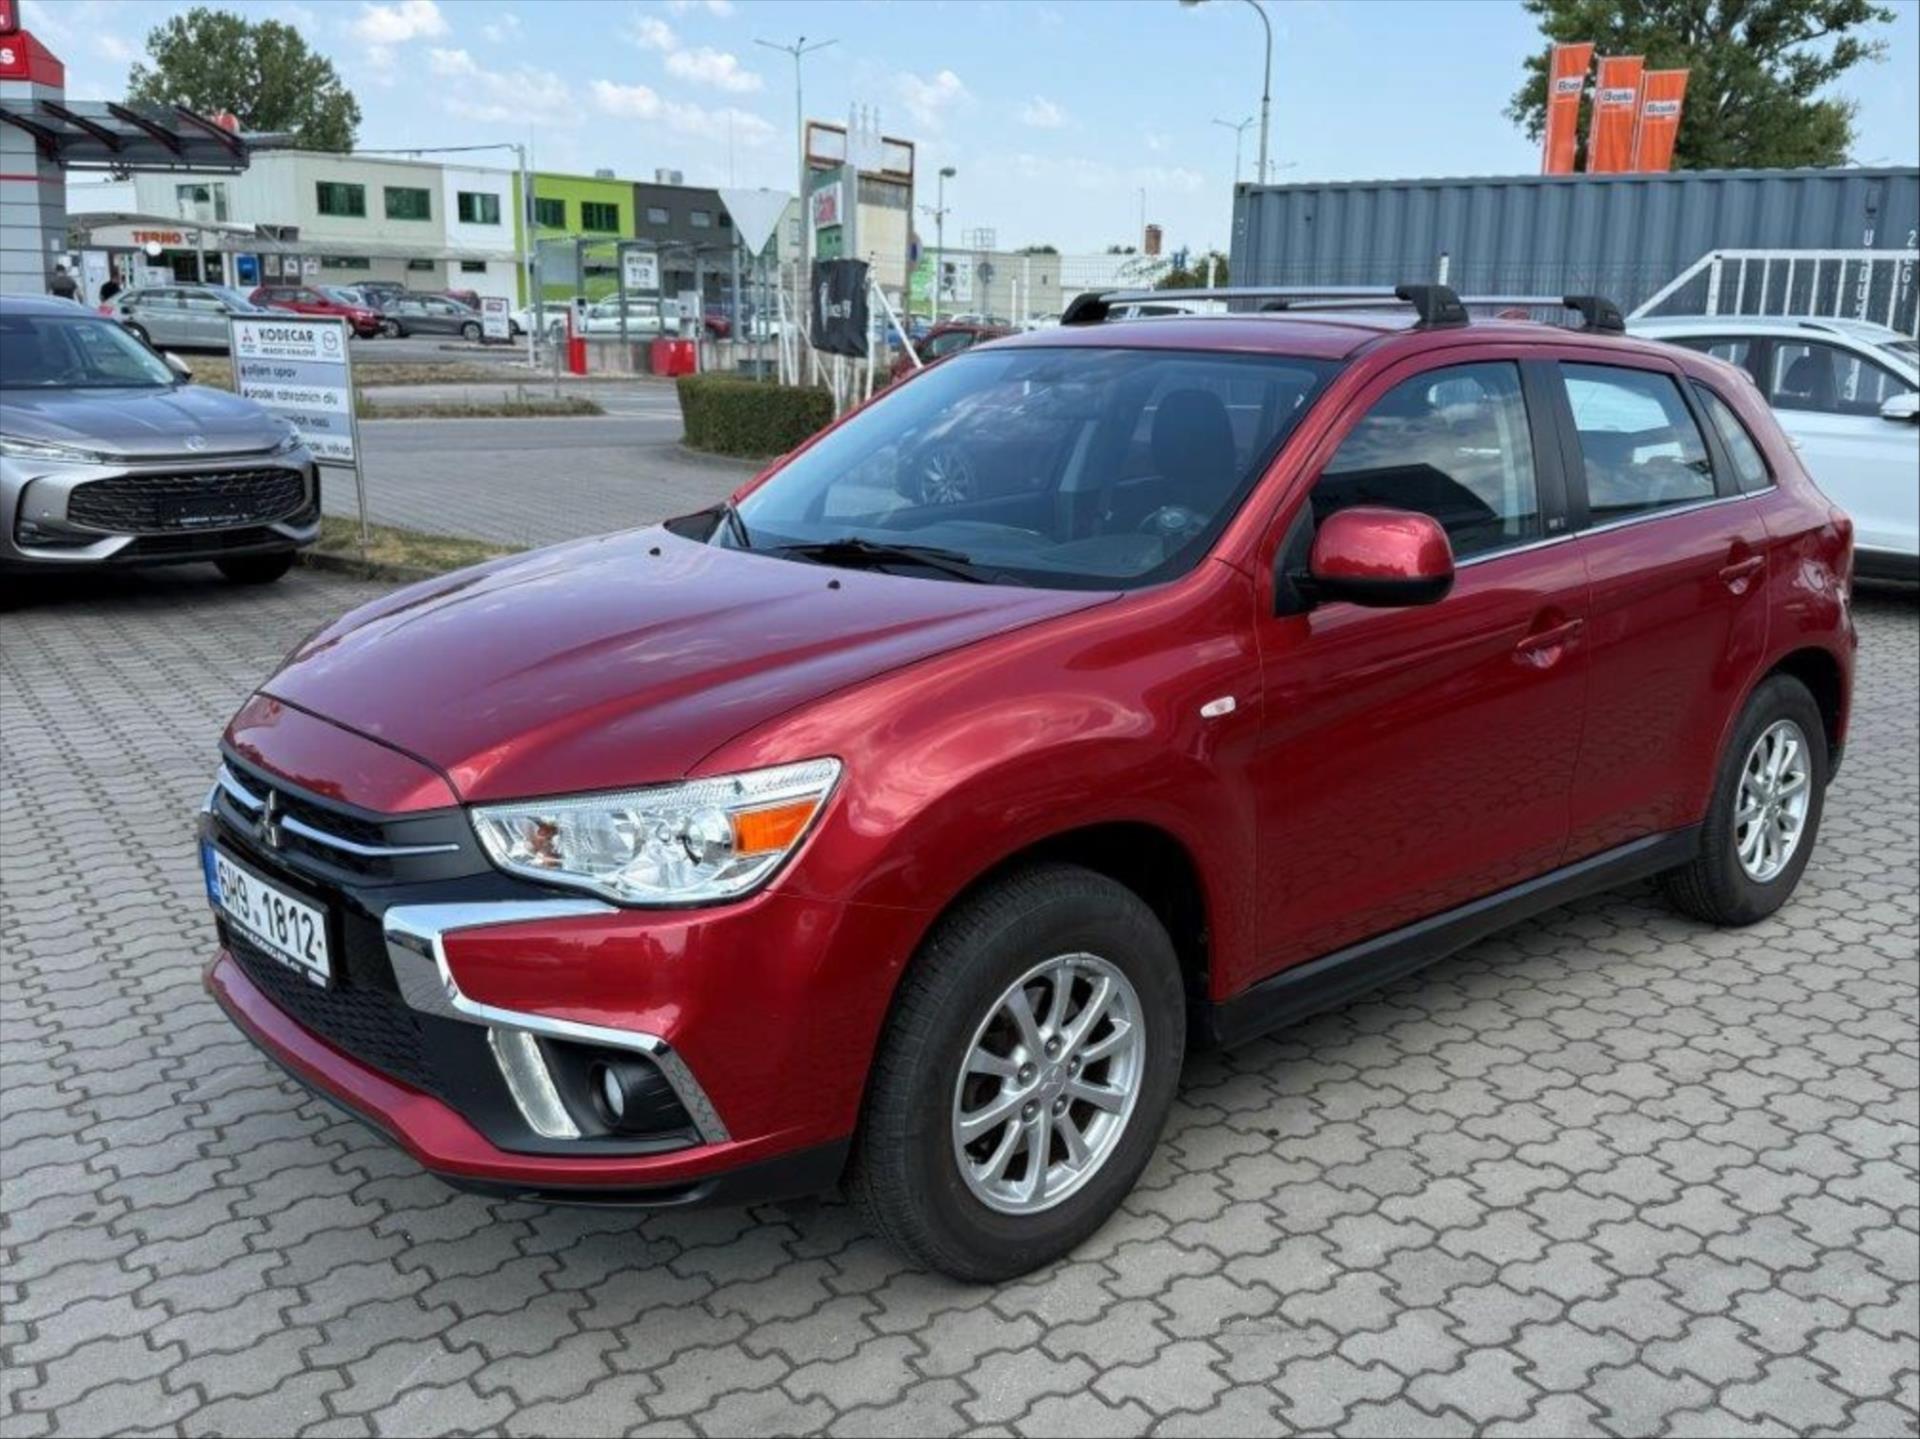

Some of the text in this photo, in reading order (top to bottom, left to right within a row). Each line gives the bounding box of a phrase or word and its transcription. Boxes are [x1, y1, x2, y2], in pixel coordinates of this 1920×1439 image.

[258, 328, 314, 341] KODECAR
[218, 860, 250, 920] 6H9
[262, 891, 318, 961] 1812
